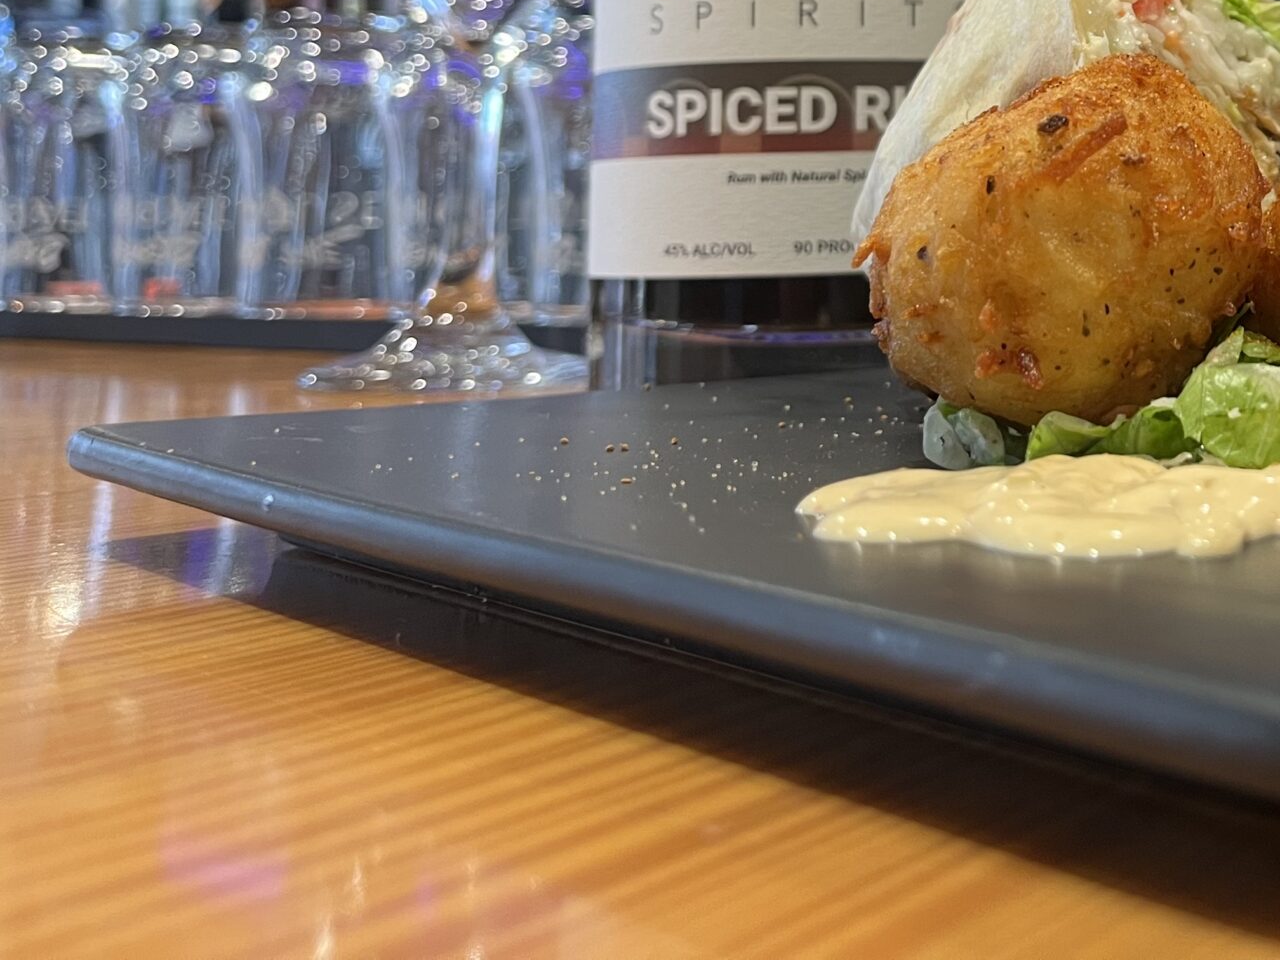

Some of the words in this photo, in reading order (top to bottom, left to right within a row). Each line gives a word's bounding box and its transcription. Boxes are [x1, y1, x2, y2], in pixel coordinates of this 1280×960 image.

[647, 85, 838, 139] SPICED
[853, 84, 911, 133] R
[760, 169, 787, 183] with
[791, 168, 841, 183] Natural
[692, 241, 757, 259] ALC/VOL
[793, 240, 814, 256] 90
[817, 238, 856, 254] PRO
